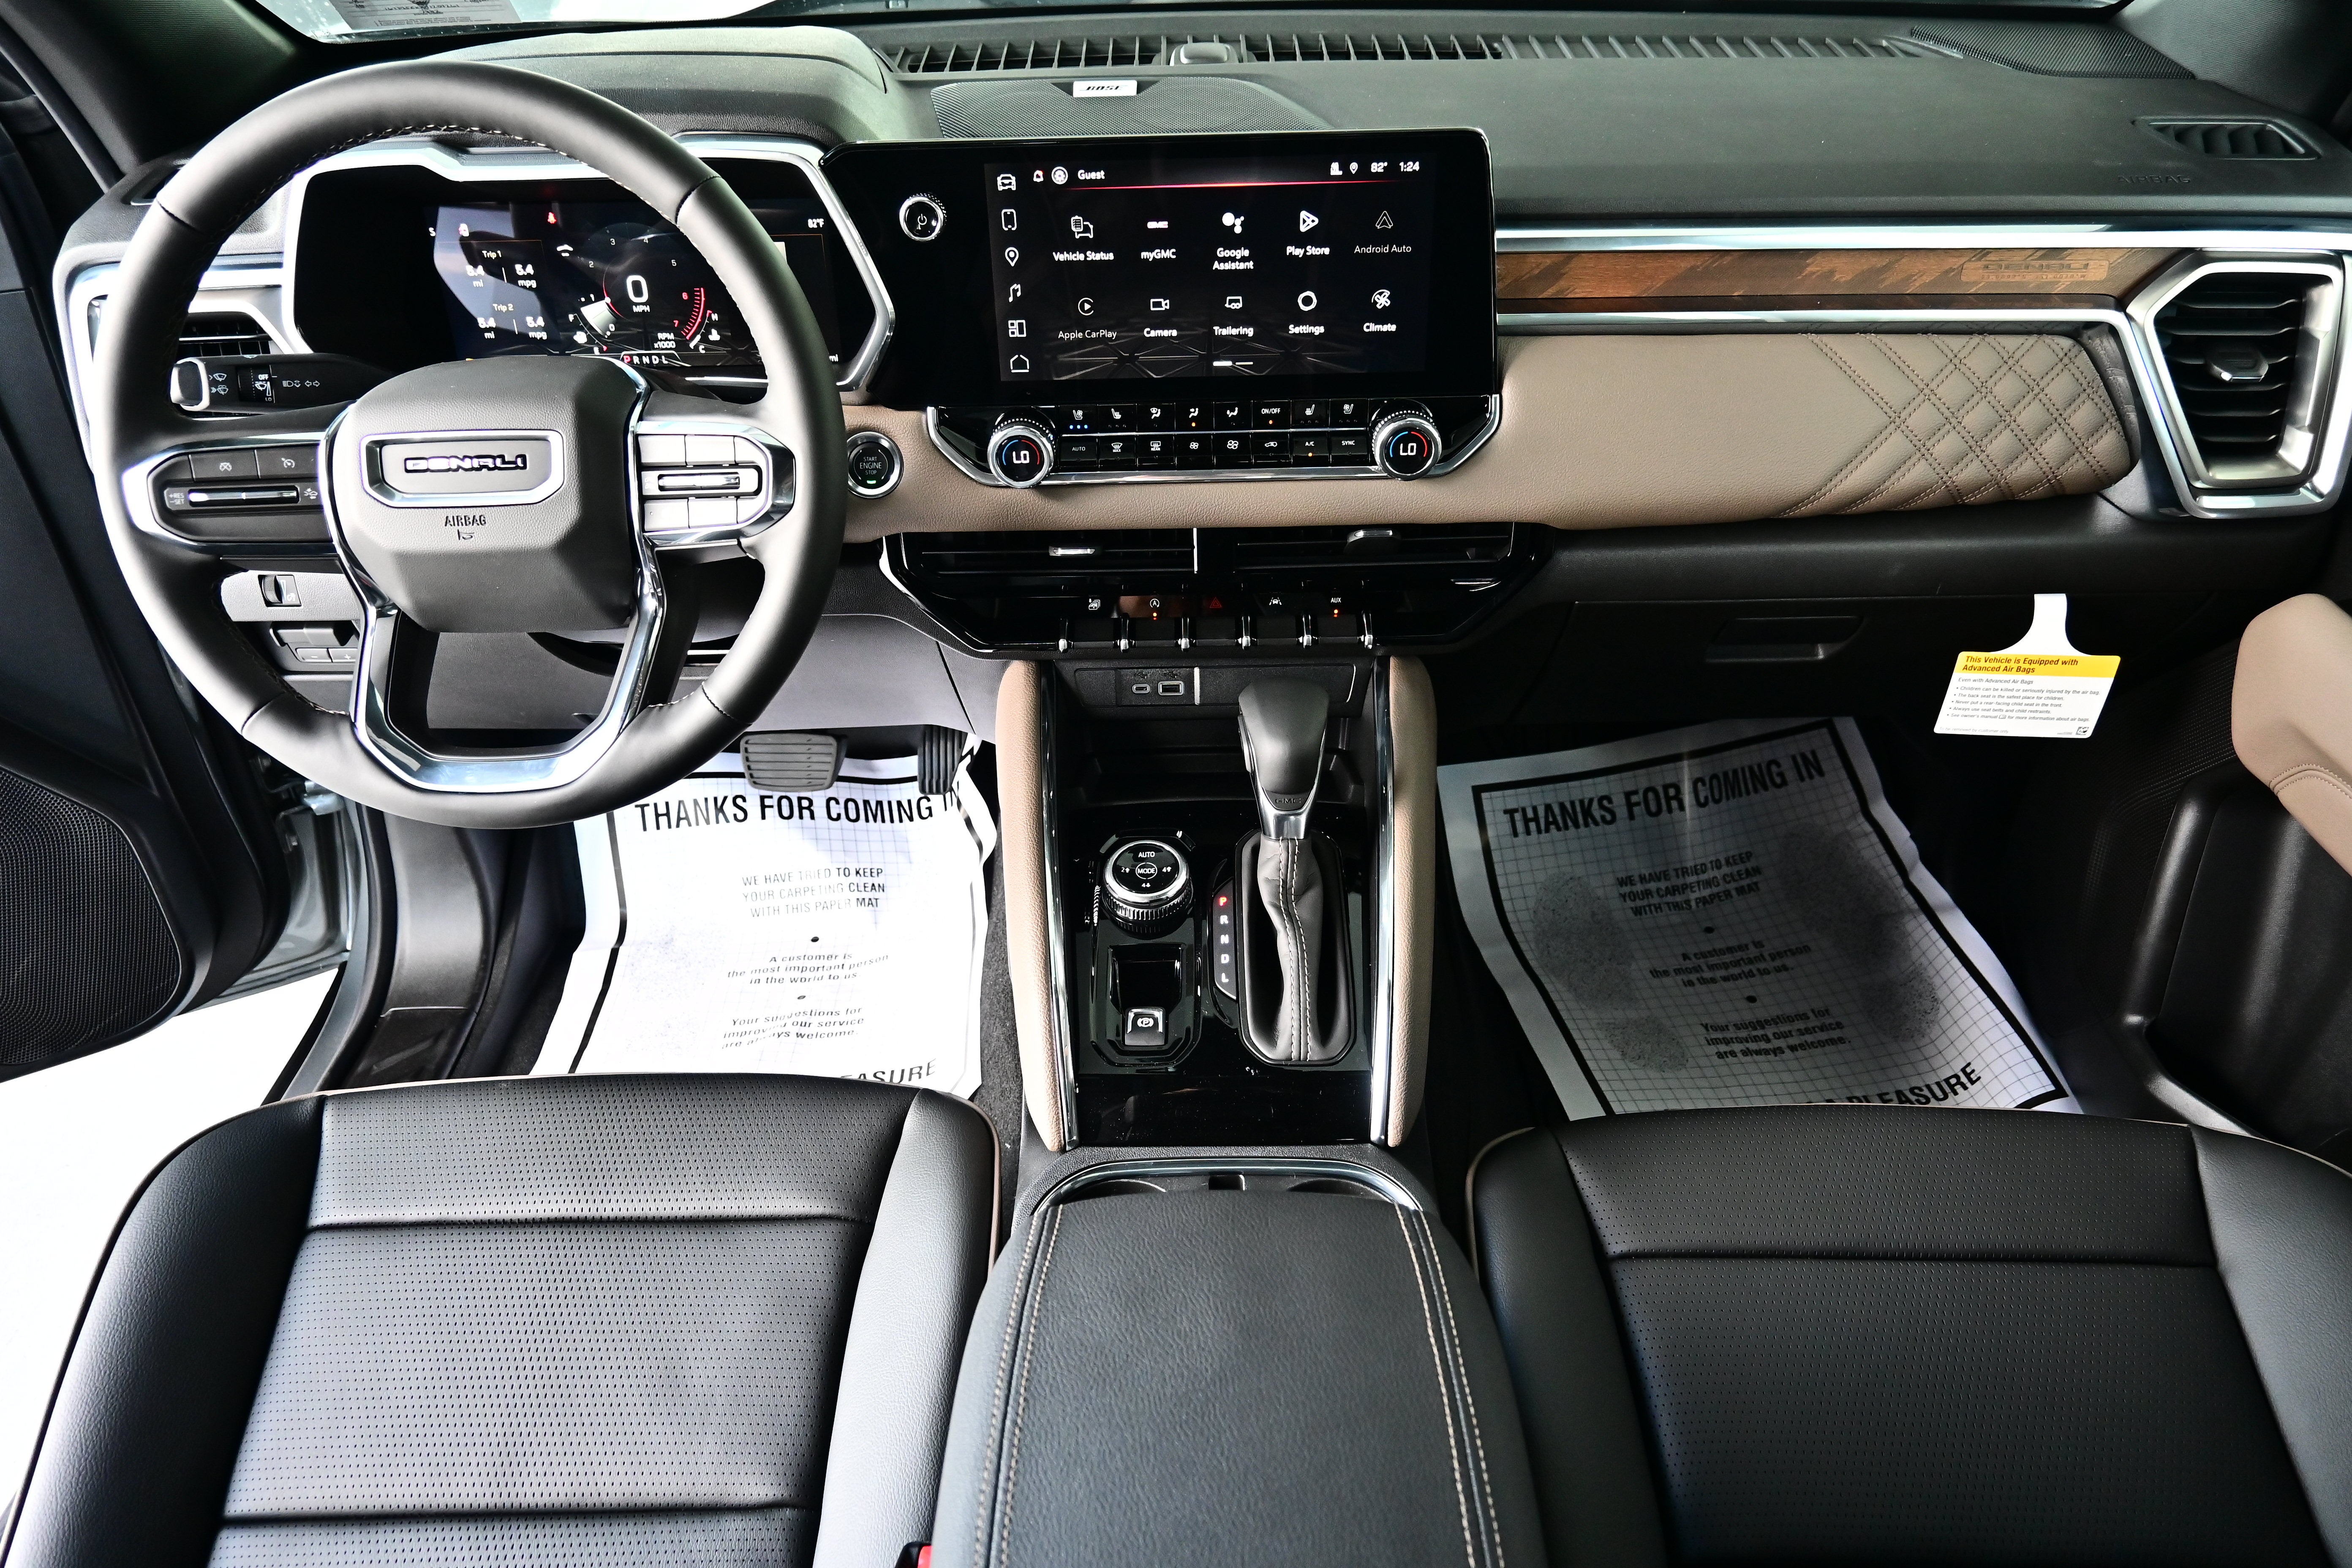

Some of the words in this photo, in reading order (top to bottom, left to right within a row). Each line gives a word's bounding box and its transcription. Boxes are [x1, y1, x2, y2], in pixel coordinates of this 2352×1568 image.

[1370, 162, 1388, 172] 82°
[1399, 161, 1420, 172] 1:24
[1078, 170, 1105, 180] Guest
[2118, 175, 2191, 183] AIRBAG
[1217, 247, 1250, 259] Google
[1286, 246, 1304, 257] Play
[1306, 245, 1330, 255] Store
[1354, 245, 1389, 253] Android
[1391, 244, 1412, 253] Auto
[482, 250, 497, 259] Trip
[1053, 252, 1084, 261] Vehicle
[1086, 251, 1114, 260] Status
[1141, 249, 1176, 260] myGMC
[466, 265, 485, 276] 5.4
[514, 264, 534, 275] 5.4
[1213, 261, 1254, 270] Assistant
[517, 279, 536, 288] mpg
[626, 275, 648, 303] 0
[493, 303, 507, 312] Trip
[477, 317, 496, 329] 5.4
[526, 316, 544, 328] 5.4
[1363, 322, 1396, 332] Climate
[485, 331, 495, 339] mi
[529, 330, 547, 340] mpg
[1058, 329, 1083, 340] Apple
[1085, 329, 1117, 340] CarPlay
[1144, 328, 1177, 338] Camera
[1213, 326, 1254, 337] Trailering
[1288, 324, 1325, 335] Settings
[633, 356, 640, 364] R
[642, 356, 650, 364] N
[652, 356, 659, 364] D
[662, 356, 668, 364] L
[1400, 442, 1416, 456] LO
[1013, 450, 1030, 464] LO
[404, 454, 527, 473] DENALI
[444, 514, 486, 527] AIRBAG
[2023, 658, 2059, 666] Equipped
[1503, 795, 1617, 838] THANKS
[1625, 783, 1685, 821] FOR
[1693, 760, 1788, 808] COMING
[1790, 750, 1825, 782] IN
[635, 794, 748, 832] THANKS
[760, 795, 815, 821] FOR
[826, 795, 933, 824] COMING
[1617, 875, 1636, 887] WE
[1639, 869, 1671, 885] HAVE
[1673, 863, 1707, 879] TRIED
[1709, 858, 1722, 871] TO
[1724, 851, 1753, 867] KEEP
[742, 876, 759, 886] WE
[765, 872, 794, 884] HAVE
[798, 868, 831, 881] TRIED
[836, 867, 850, 877] TO
[855, 868, 883, 877] KEEP
[1619, 888, 1654, 903] YOUR
[1656, 876, 1720, 898] CARPETING
[1723, 866, 1762, 884] CLEAN
[743, 890, 774, 902] YOUR
[780, 883, 844, 899] CARPETING
[849, 882, 885, 893] CLEAN
[1219, 897, 1227, 906] P
[1631, 903, 1663, 917] WITH
[1665, 900, 1692, 911] THIS
[1695, 889, 1733, 907] PAPER
[1735, 882, 1760, 896] MAT
[750, 905, 780, 917] WITH
[786, 902, 810, 914] THIS
[815, 899, 851, 911] PAPER
[856, 898, 880, 908] MAT
[1220, 915, 1229, 924] R
[1220, 935, 1229, 944] N
[1681, 953, 1691, 961] A
[1693, 943, 1750, 960] customer
[1752, 940, 1765, 949] is
[782, 954, 838, 962] customer
[1221, 954, 1229, 963] D
[1650, 969, 1669, 978] the
[1673, 964, 1704, 975] most
[1707, 953, 1767, 971] important
[1768, 945, 1811, 961] person
[751, 966, 780, 975] most
[785, 963, 845, 973] important
[849, 955, 888, 970] person
[790, 975, 824, 983] world
[1221, 974, 1229, 983] L
[1681, 978, 1696, 987] in
[1696, 976, 1718, 985] the
[1720, 969, 1756, 982] world
[1756, 967, 1771, 976] to
[732, 1018, 760, 1026] Your
[846, 1007, 863, 1015] for
[1700, 1023, 1730, 1032] Your
[1733, 1013, 1810, 1031] suggestions
[1810, 1007, 1831, 1018] for
[817, 1018, 864, 1028] service
[1705, 1034, 1771, 1046] improving
[1772, 1030, 1794, 1040] our
[1797, 1021, 1844, 1035] service
[722, 1041, 742, 1049] are
[1715, 1049, 1738, 1059] are
[1740, 1046, 1785, 1056] always
[1787, 1036, 1851, 1053] welcome.
